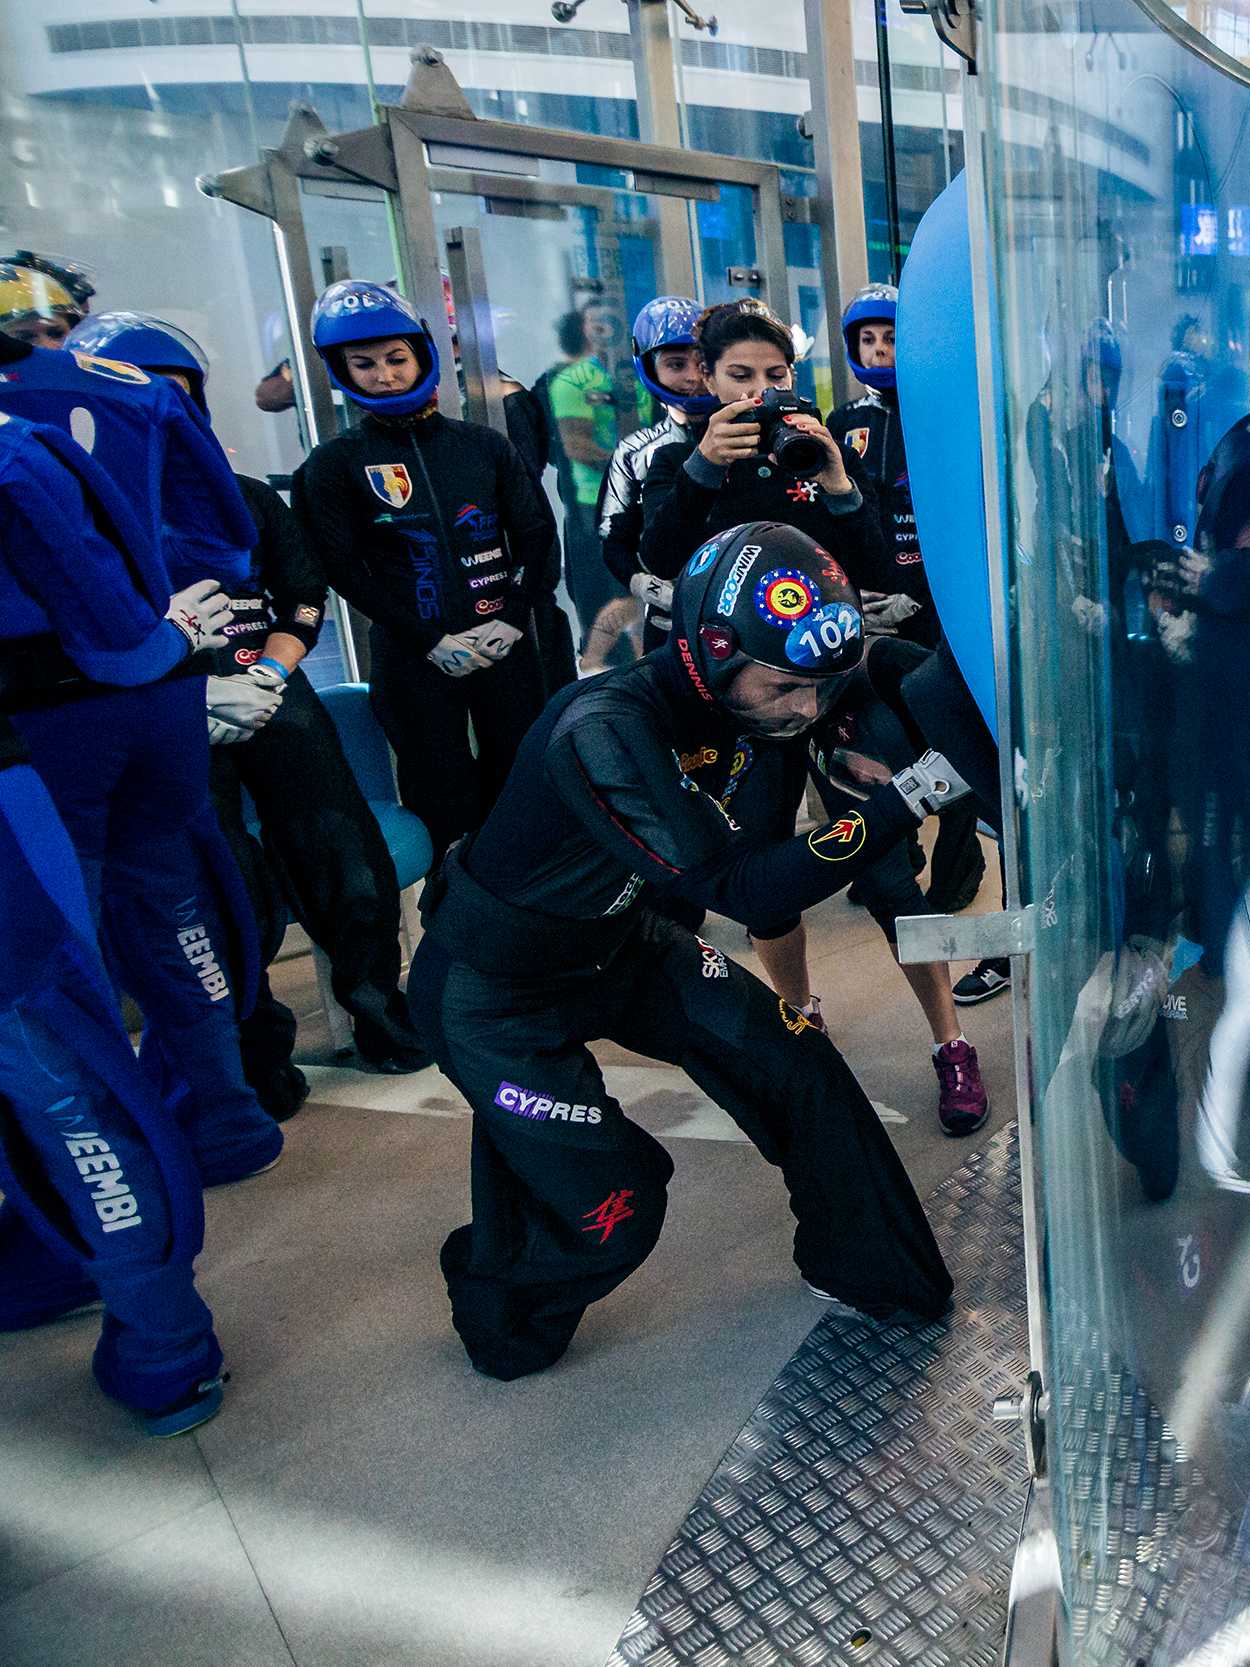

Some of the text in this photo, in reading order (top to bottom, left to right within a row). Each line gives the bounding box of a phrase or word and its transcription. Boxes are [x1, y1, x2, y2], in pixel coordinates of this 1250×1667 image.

[719, 545, 761, 615] WINDOOR
[800, 609, 858, 657] 102
[677, 638, 714, 702] DENNIS
[499, 1087, 603, 1125] CYPRES
